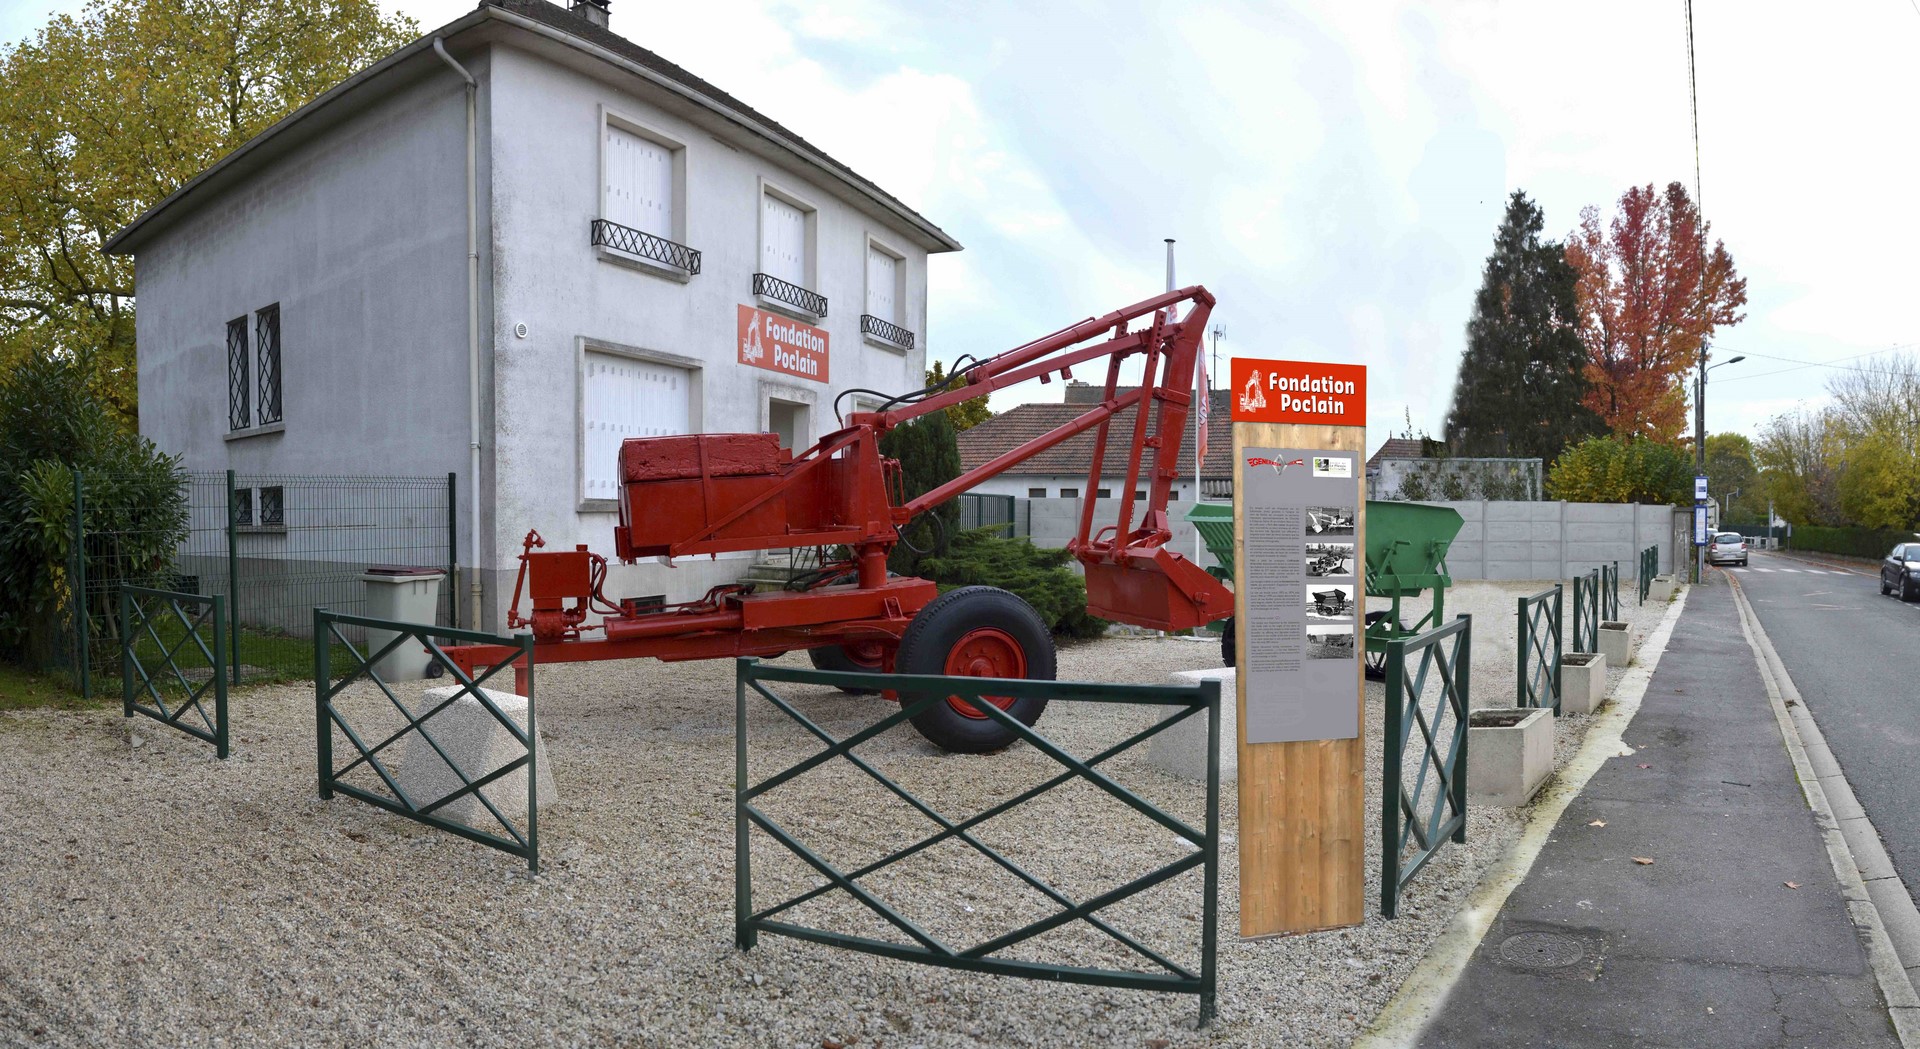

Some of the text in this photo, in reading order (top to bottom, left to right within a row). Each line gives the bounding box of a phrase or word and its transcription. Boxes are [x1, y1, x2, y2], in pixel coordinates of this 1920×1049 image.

[766, 316, 824, 353] Fondation
[774, 344, 817, 376] Poclain
[1269, 372, 1355, 395] Fondation
[1281, 393, 1344, 415] Poclain
